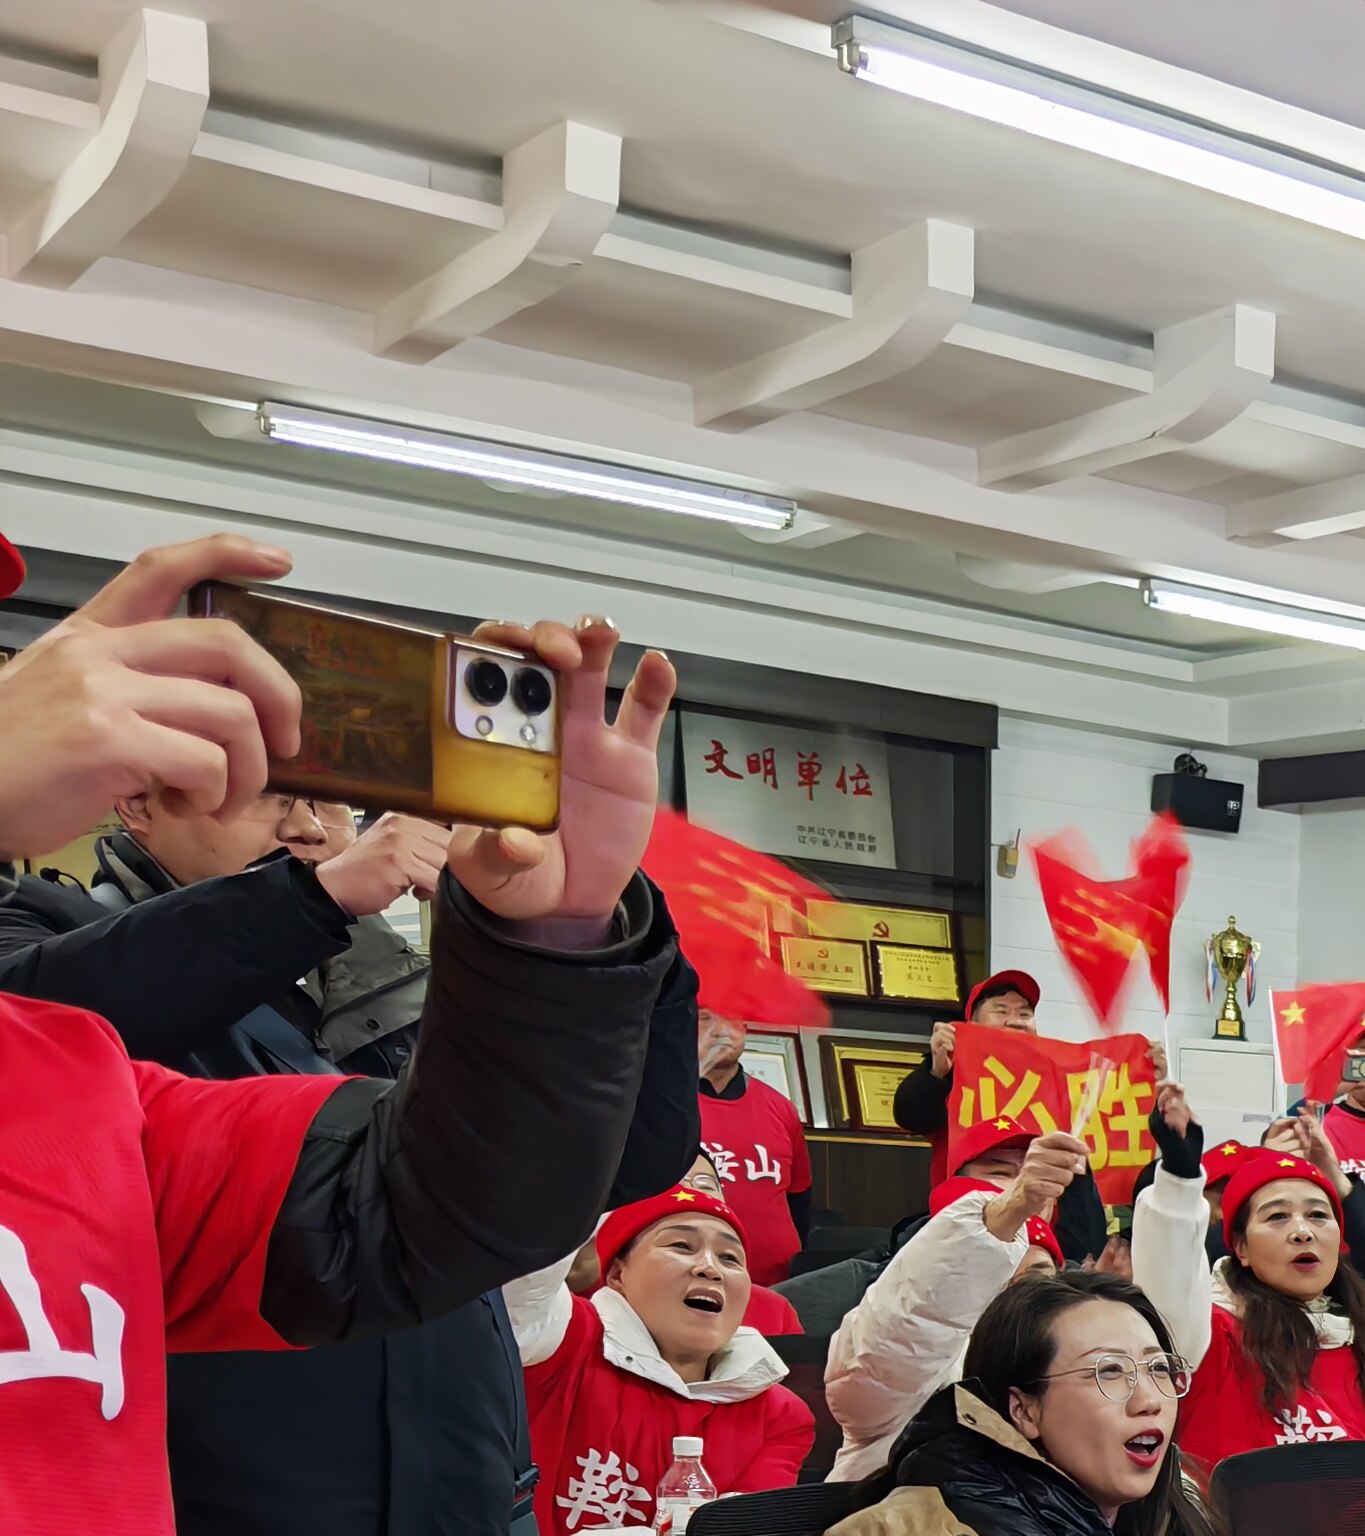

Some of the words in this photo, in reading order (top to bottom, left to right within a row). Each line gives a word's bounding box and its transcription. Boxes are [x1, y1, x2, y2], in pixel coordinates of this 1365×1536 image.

[703, 739, 873, 801] 文明单位
[958, 1055, 1153, 1171] 必胜
